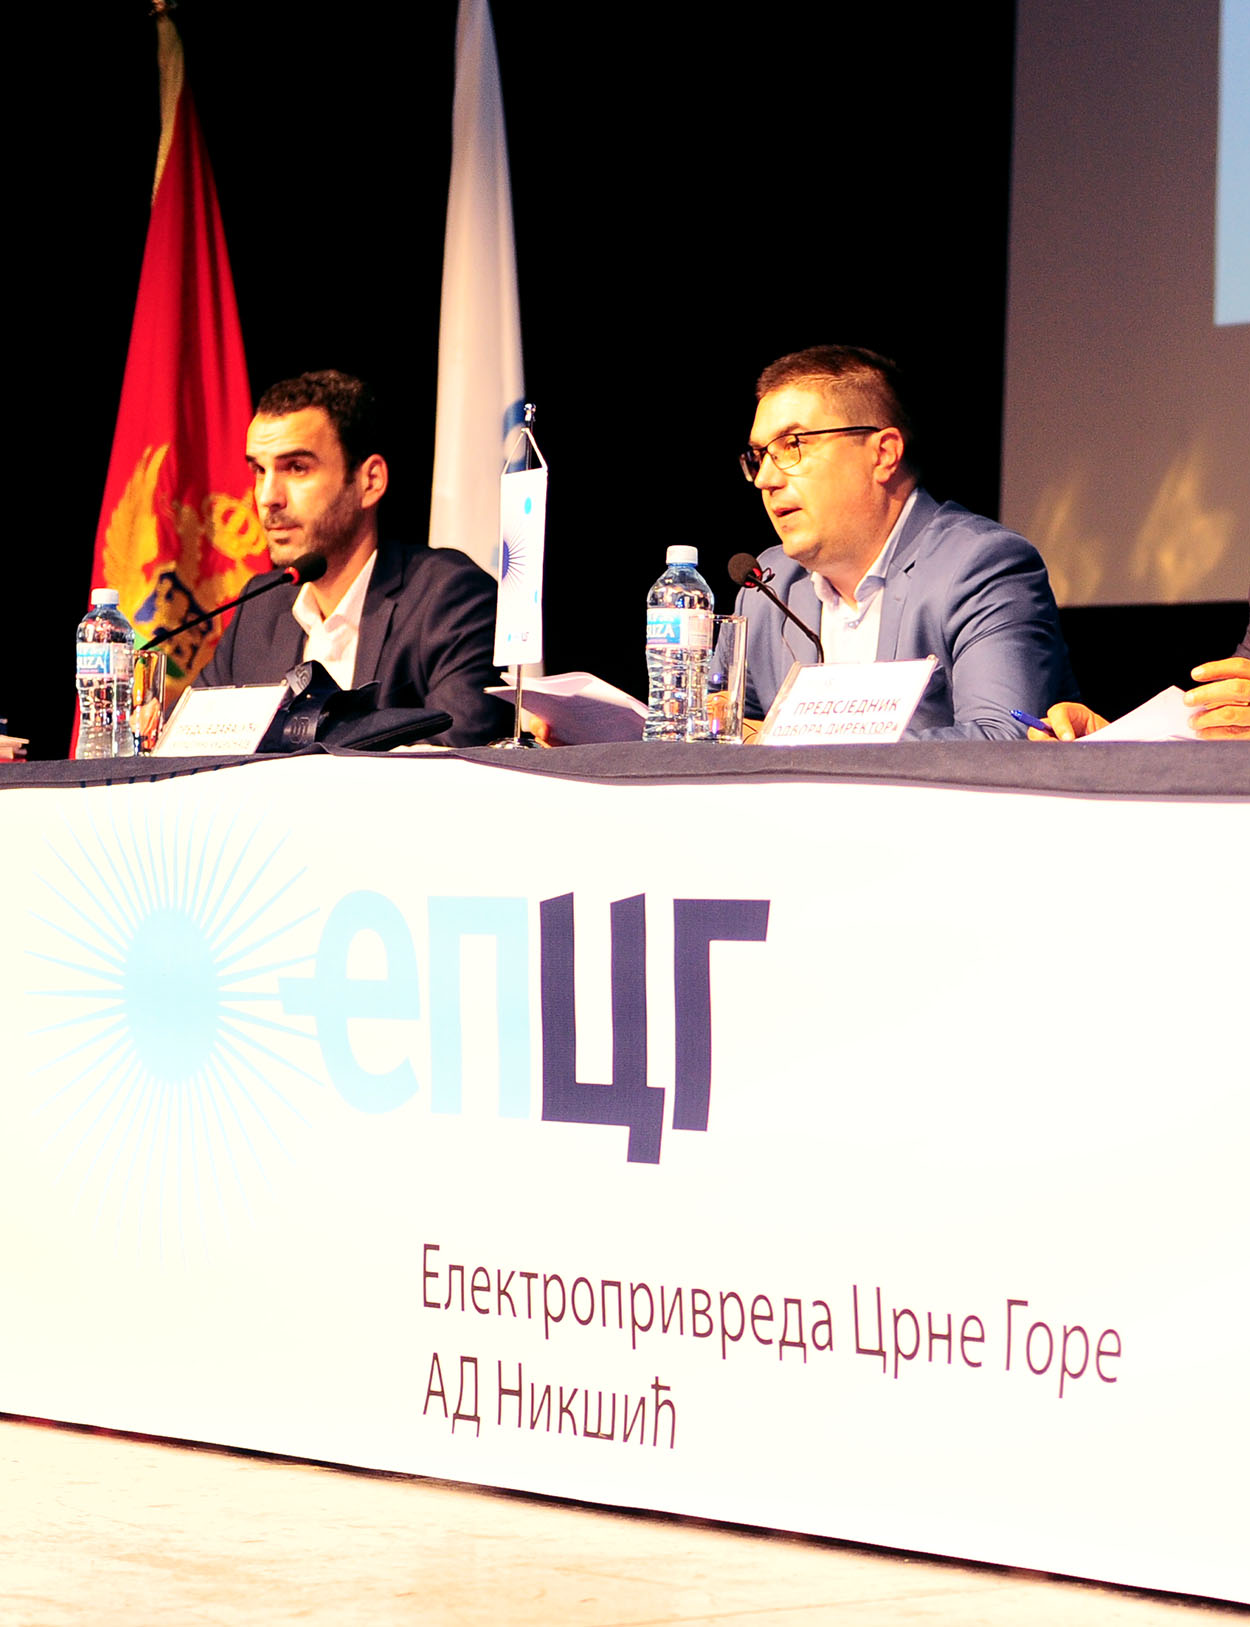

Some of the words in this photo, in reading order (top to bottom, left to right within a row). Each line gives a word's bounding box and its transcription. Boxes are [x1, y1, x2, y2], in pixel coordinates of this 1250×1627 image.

[793, 698, 901, 717] ПРЕДСЈЕДНИК
[825, 720, 899, 736] ДИРЕКТОРА
[422, 1242, 834, 1365] Електропривреда
[852, 1283, 986, 1380] Црне
[1005, 1298, 1122, 1399] Горе
[422, 1351, 481, 1439] АД
[497, 1359, 677, 1450] Никшић
